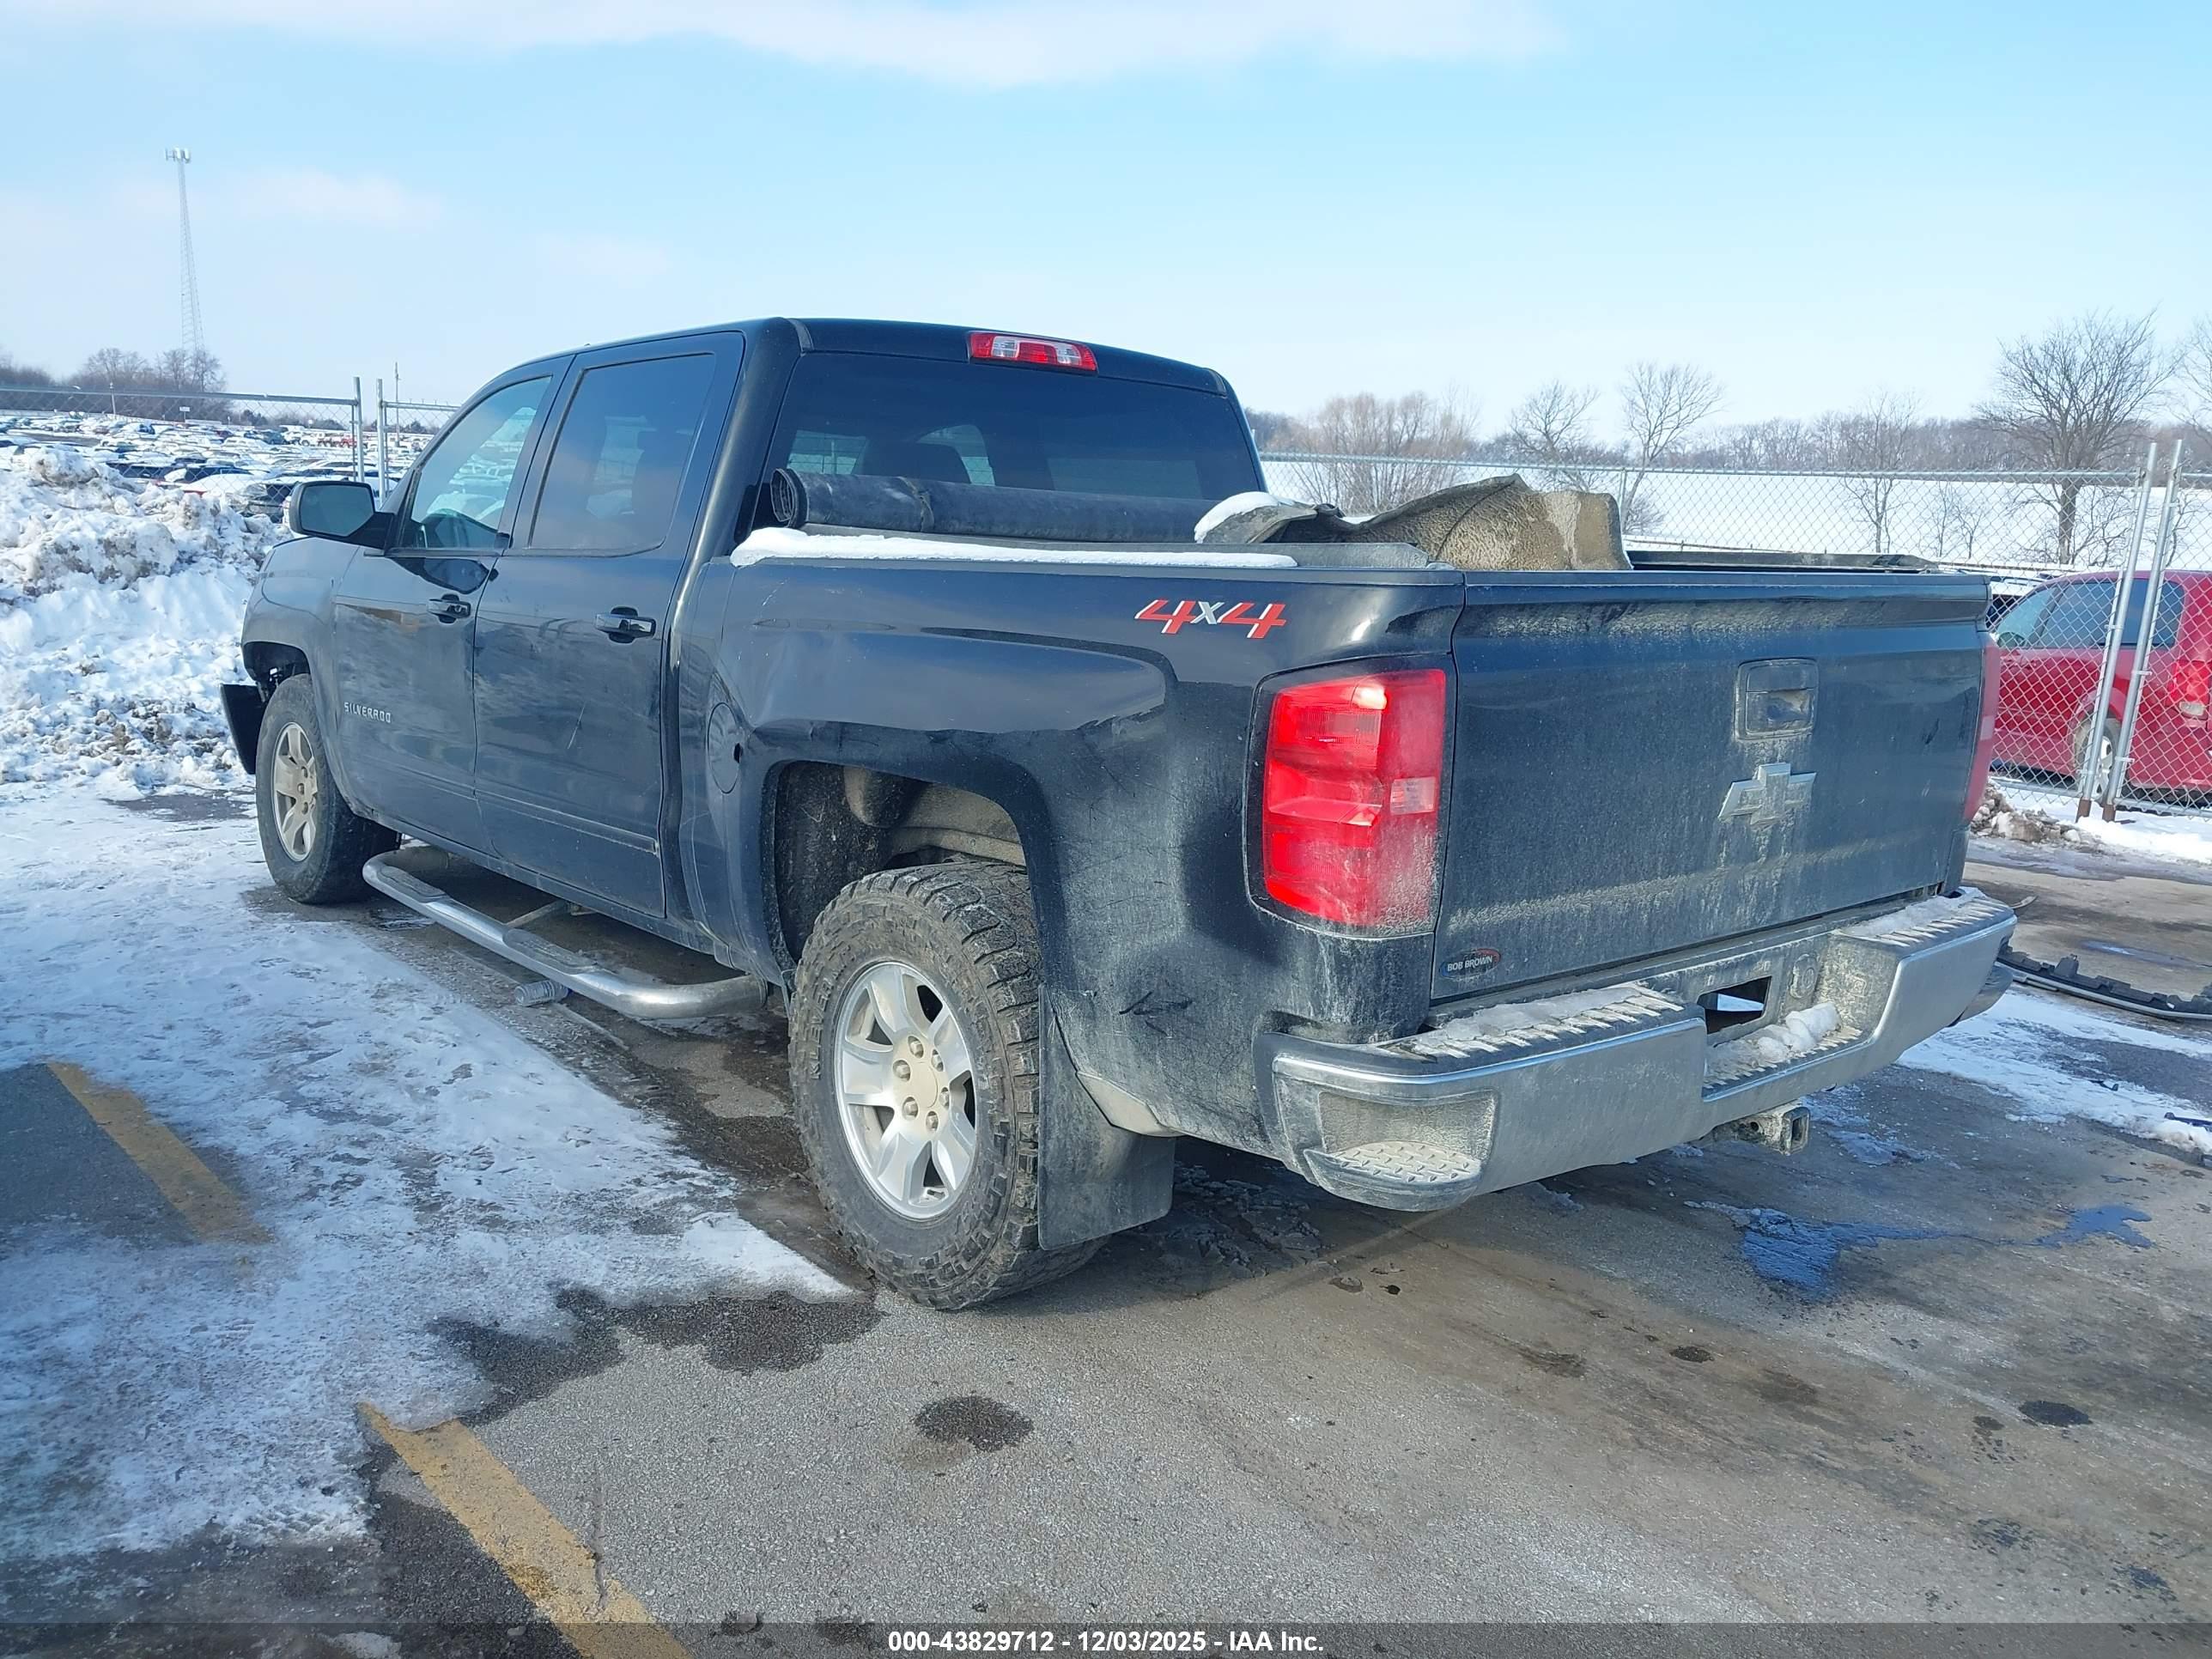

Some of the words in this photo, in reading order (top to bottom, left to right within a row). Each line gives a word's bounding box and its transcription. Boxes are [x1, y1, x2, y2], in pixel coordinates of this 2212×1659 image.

[343, 702, 392, 724] SILVERADO
[1447, 961, 1464, 972] BOB
[1464, 955, 1493, 969] BROWN
